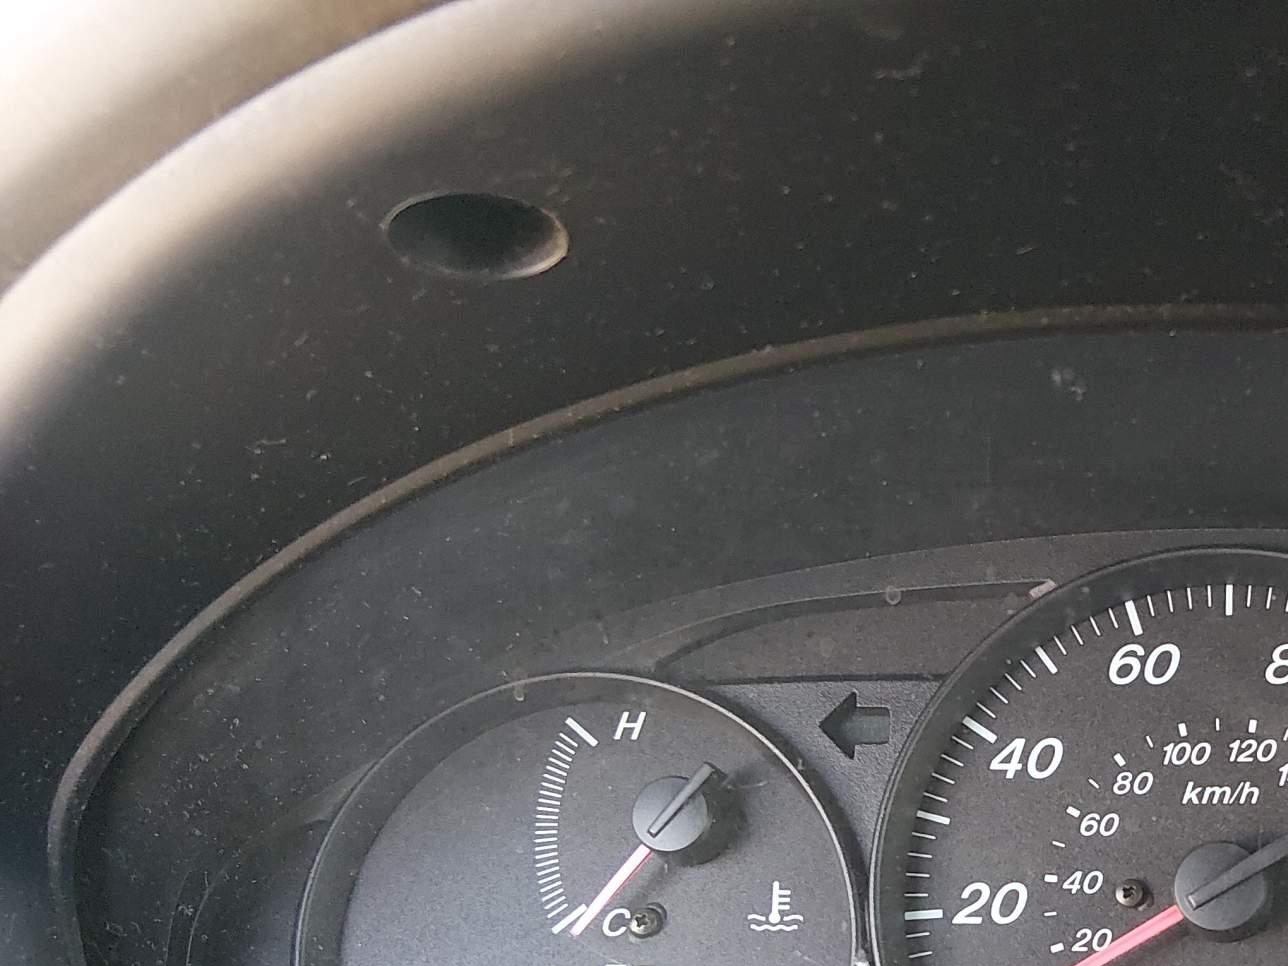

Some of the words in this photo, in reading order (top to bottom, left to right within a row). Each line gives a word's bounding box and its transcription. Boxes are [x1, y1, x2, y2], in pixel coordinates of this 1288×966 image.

[1109, 644, 1180, 684] 60
[614, 712, 646, 740] H
[990, 738, 1063, 778] 40
[1164, 743, 1211, 765] 100
[1230, 739, 1277, 762] 120
[1113, 772, 1153, 794] 80
[1182, 782, 1259, 804] km/h
[1080, 813, 1119, 836] 60
[1063, 871, 1103, 894] 40
[952, 883, 1027, 924] 20
[602, 908, 630, 936] C
[1072, 929, 1112, 952] 20
